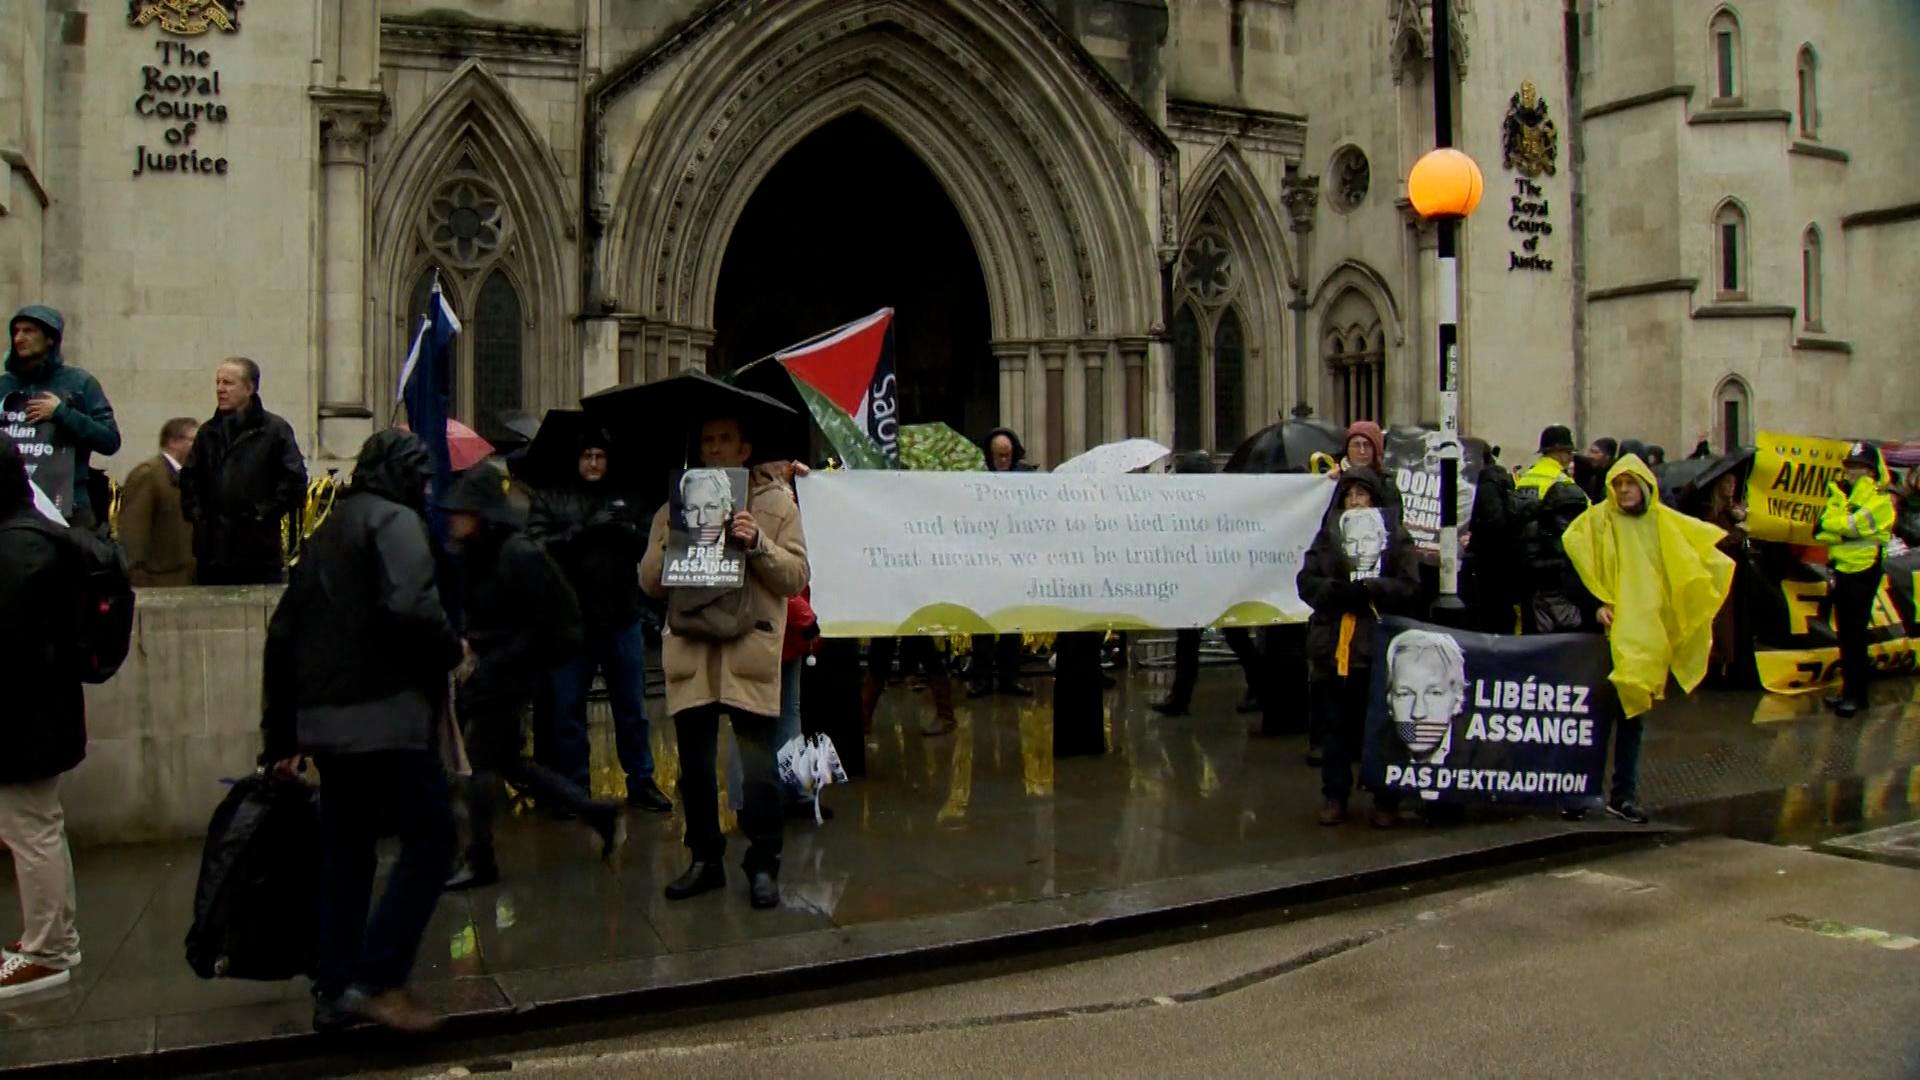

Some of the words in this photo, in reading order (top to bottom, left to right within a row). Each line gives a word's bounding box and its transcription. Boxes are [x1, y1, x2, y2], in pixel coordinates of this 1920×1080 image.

[156, 41, 211, 67] The
[142, 66, 220, 97] Royal
[136, 94, 228, 122] Courts
[165, 122, 196, 145] of
[133, 146, 228, 177] Justice
[1515, 178, 1542, 196] The
[1511, 197, 1548, 217] Royal
[1508, 214, 1552, 235] Courts
[1523, 236, 1538, 250] of
[1508, 252, 1553, 271] Justice
[1115, 484, 1151, 502] like
[1161, 488, 1206, 502] wars
[903, 515, 945, 535] and
[953, 515, 1000, 540] they
[1006, 514, 1057, 534] have
[1065, 518, 1087, 532] to
[1094, 513, 1119, 532] be
[1171, 513, 1210, 532] into
[687, 545, 724, 559] FREE
[863, 547, 921, 567] That
[1009, 553, 1038, 565] we
[1047, 551, 1085, 565] can
[1093, 546, 1117, 564] be
[1204, 545, 1241, 564] into
[668, 559, 740, 573] ASSANGE
[1027, 577, 1093, 599] Julian
[1100, 578, 1179, 600] Assange
[1474, 675, 1590, 714] LIBÉREZ
[1465, 713, 1594, 746] ASSANGE
[1384, 765, 1433, 788] PAS
[1436, 768, 1588, 793] D'EXTRADITION
